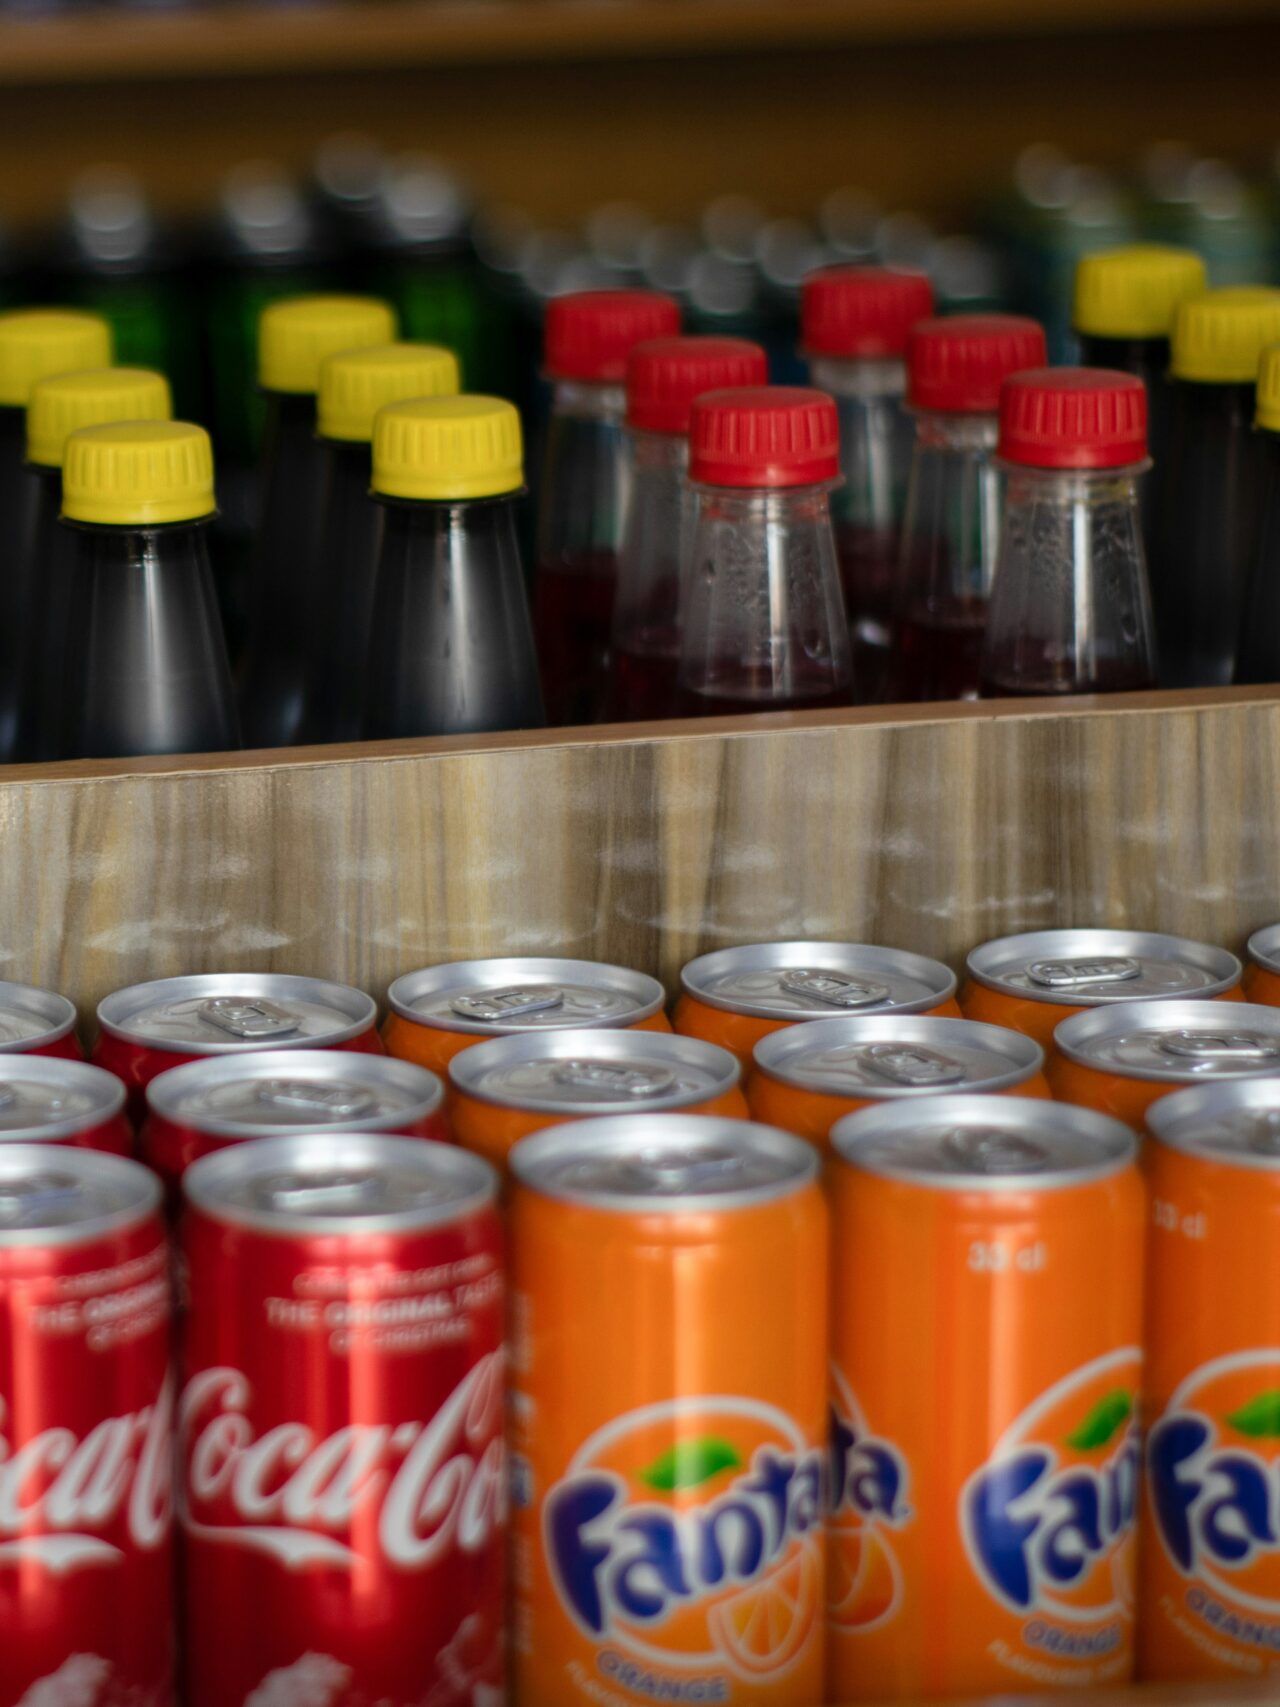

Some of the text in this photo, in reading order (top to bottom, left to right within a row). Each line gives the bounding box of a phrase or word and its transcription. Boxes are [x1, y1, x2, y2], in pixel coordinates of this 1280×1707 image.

[265, 1297, 320, 1328] THE
[324, 1291, 452, 1327] ORIGINAL
[542, 1443, 827, 1642] Fanta
[1021, 1619, 1122, 1658] ORANGE
[597, 1650, 730, 1702] ORANGE
